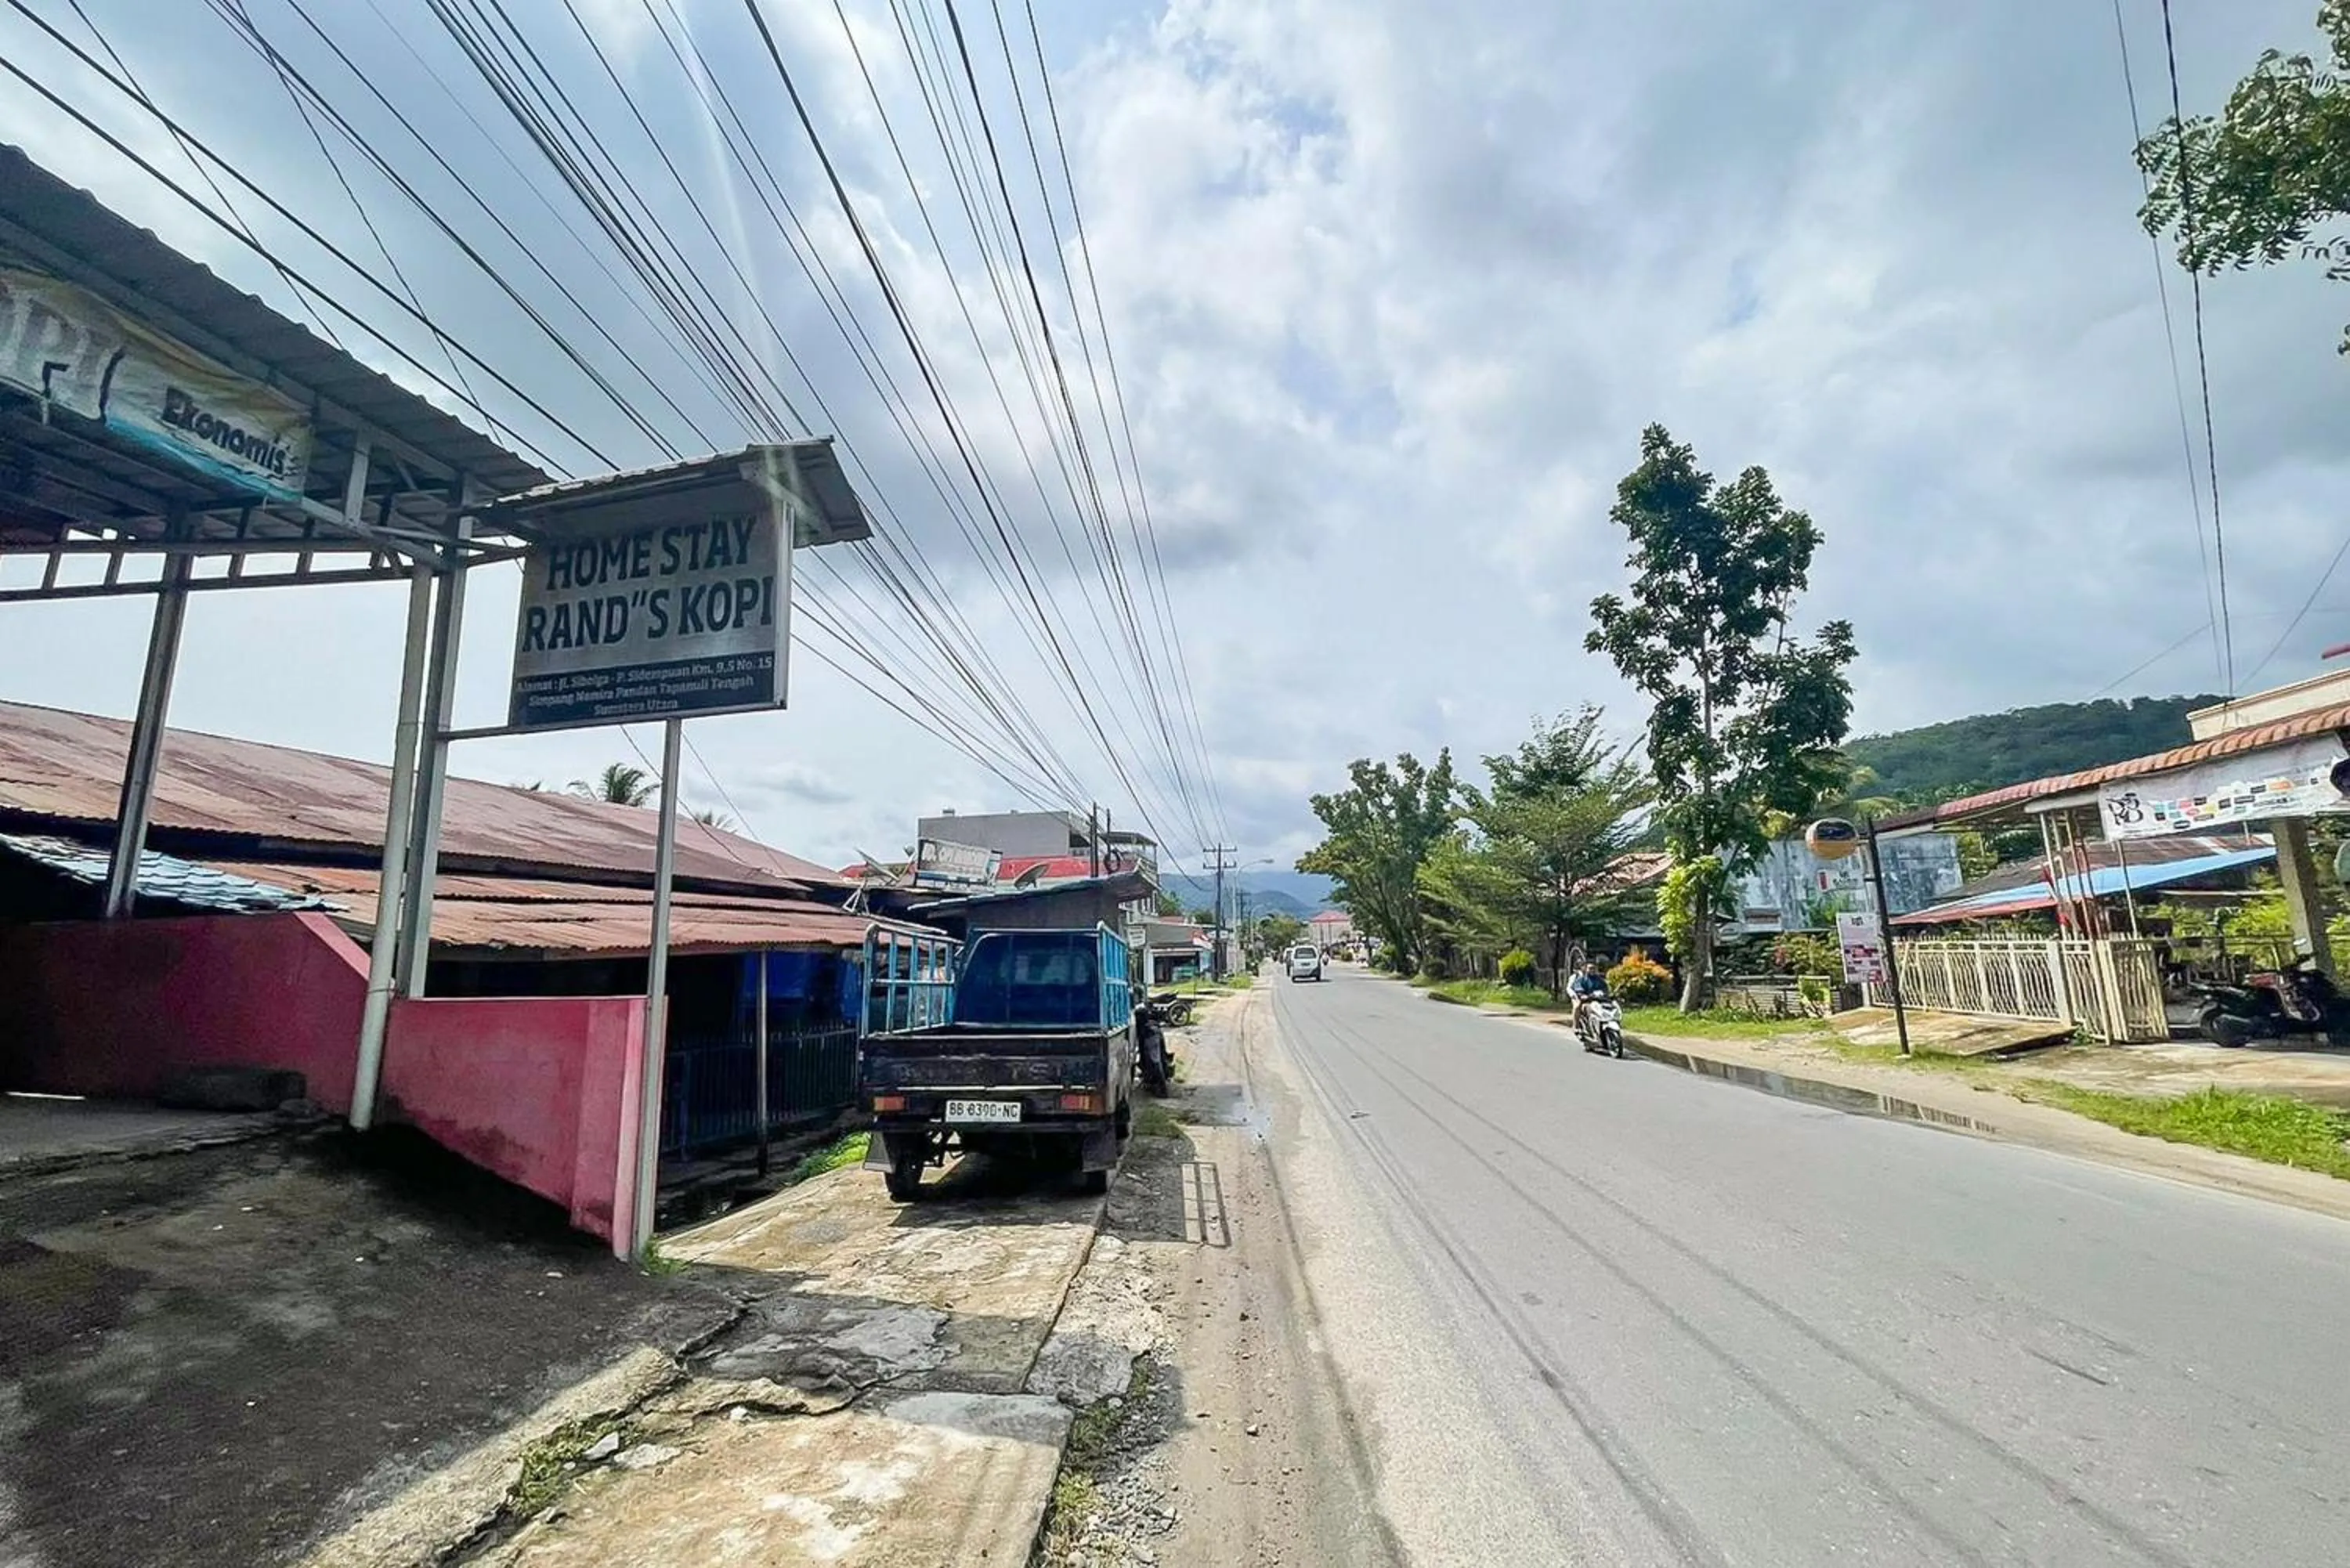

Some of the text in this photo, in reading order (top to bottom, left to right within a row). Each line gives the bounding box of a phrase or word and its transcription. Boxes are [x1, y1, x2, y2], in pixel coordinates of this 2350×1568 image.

[161, 386, 288, 475] Ekonomis
[545, 515, 757, 591] HOME STAY
[678, 576, 774, 635] KOPI
[712, 674, 754, 689] Tengah
[758, 656, 772, 668] 15
